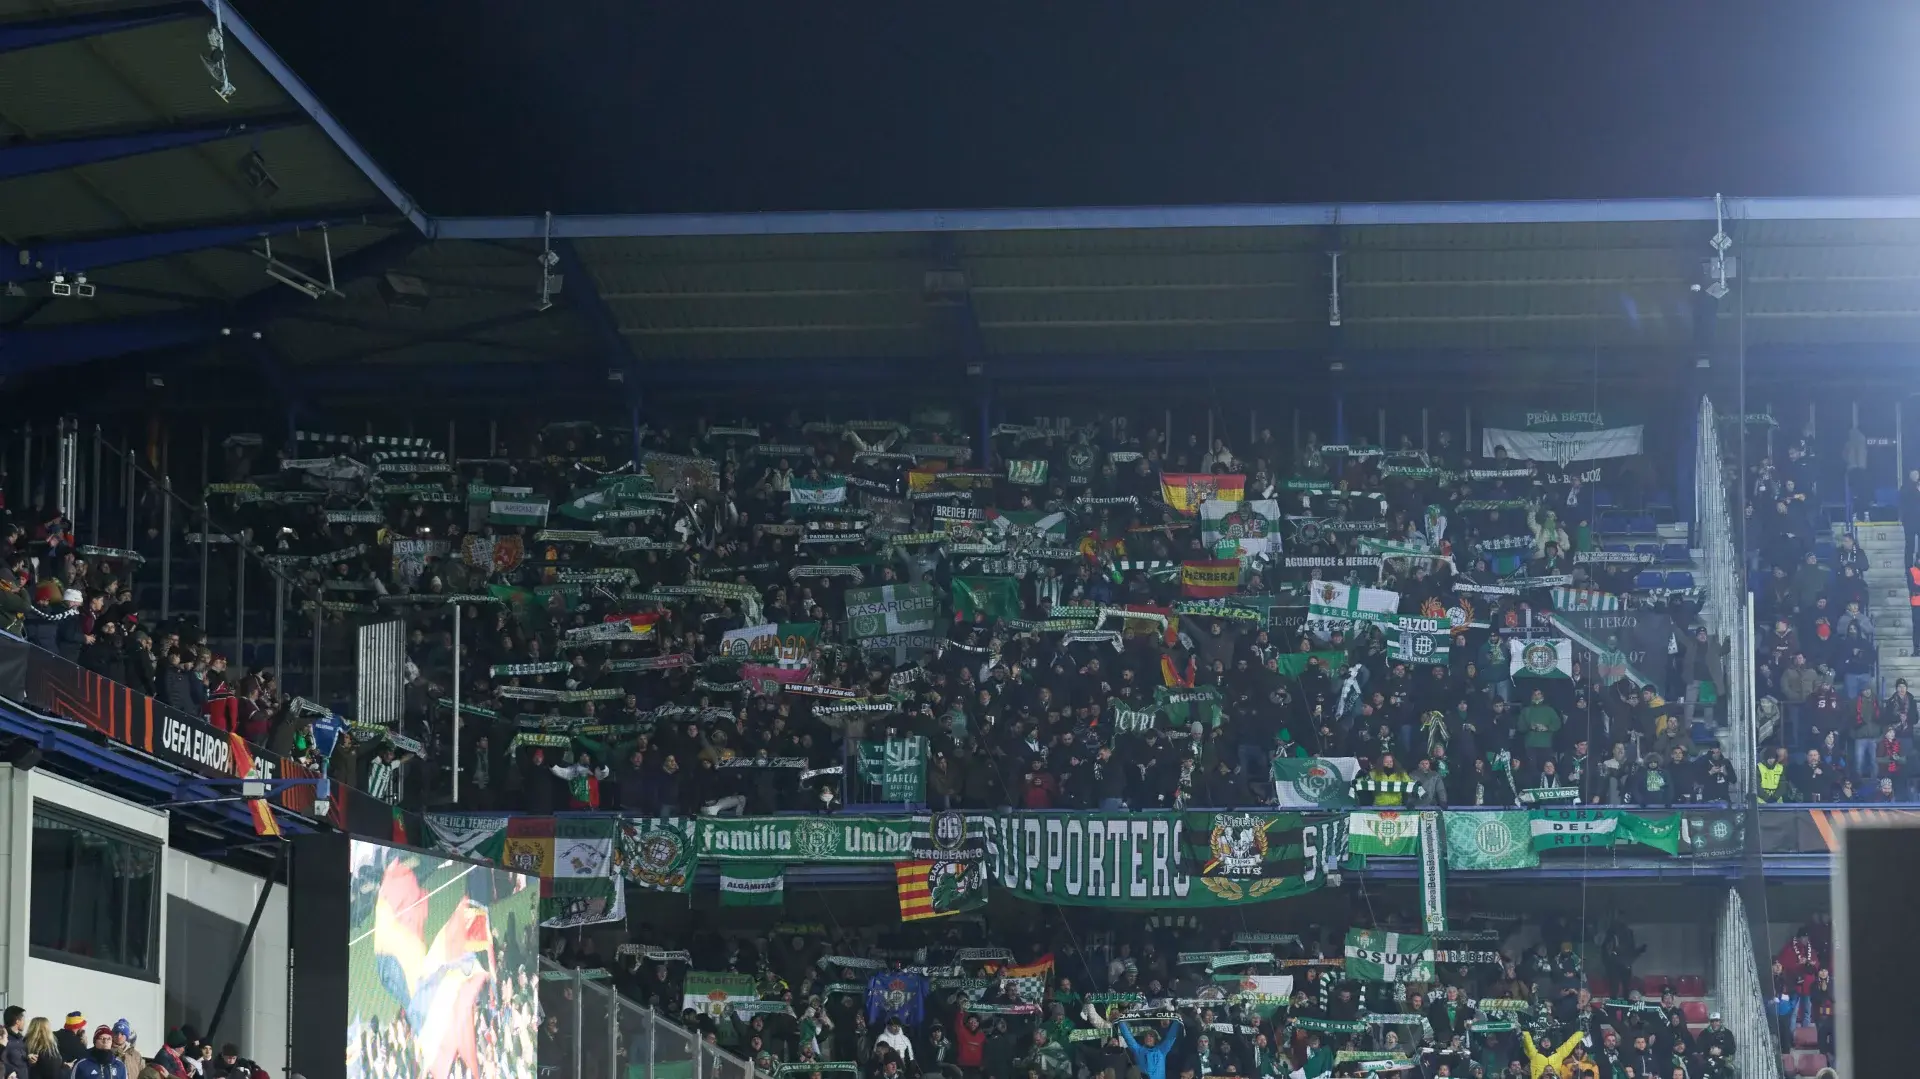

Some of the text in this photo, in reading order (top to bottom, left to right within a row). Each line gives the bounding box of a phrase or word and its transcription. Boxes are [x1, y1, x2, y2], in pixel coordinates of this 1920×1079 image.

[1526, 411, 1557, 426] PEÑA
[936, 505, 966, 518] BRENES
[1285, 557, 1336, 567] AGUADULCE
[1338, 557, 1344, 566] &
[1185, 568, 1235, 582] HERRERA
[847, 596, 933, 617] CASARICHE
[1352, 611, 1381, 621] BARRIL
[162, 716, 192, 758] UEFA
[192, 729, 234, 776] EUROPA
[1545, 810, 1603, 820] LORA
[937, 817, 959, 839] 86
[1553, 823, 1594, 831] DEL
[911, 848, 983, 860] VERDIBLANCO
[983, 816, 1190, 898] SUPPORTERS
[1217, 864, 1263, 875] Fans
[1356, 948, 1425, 966] OSUNA
